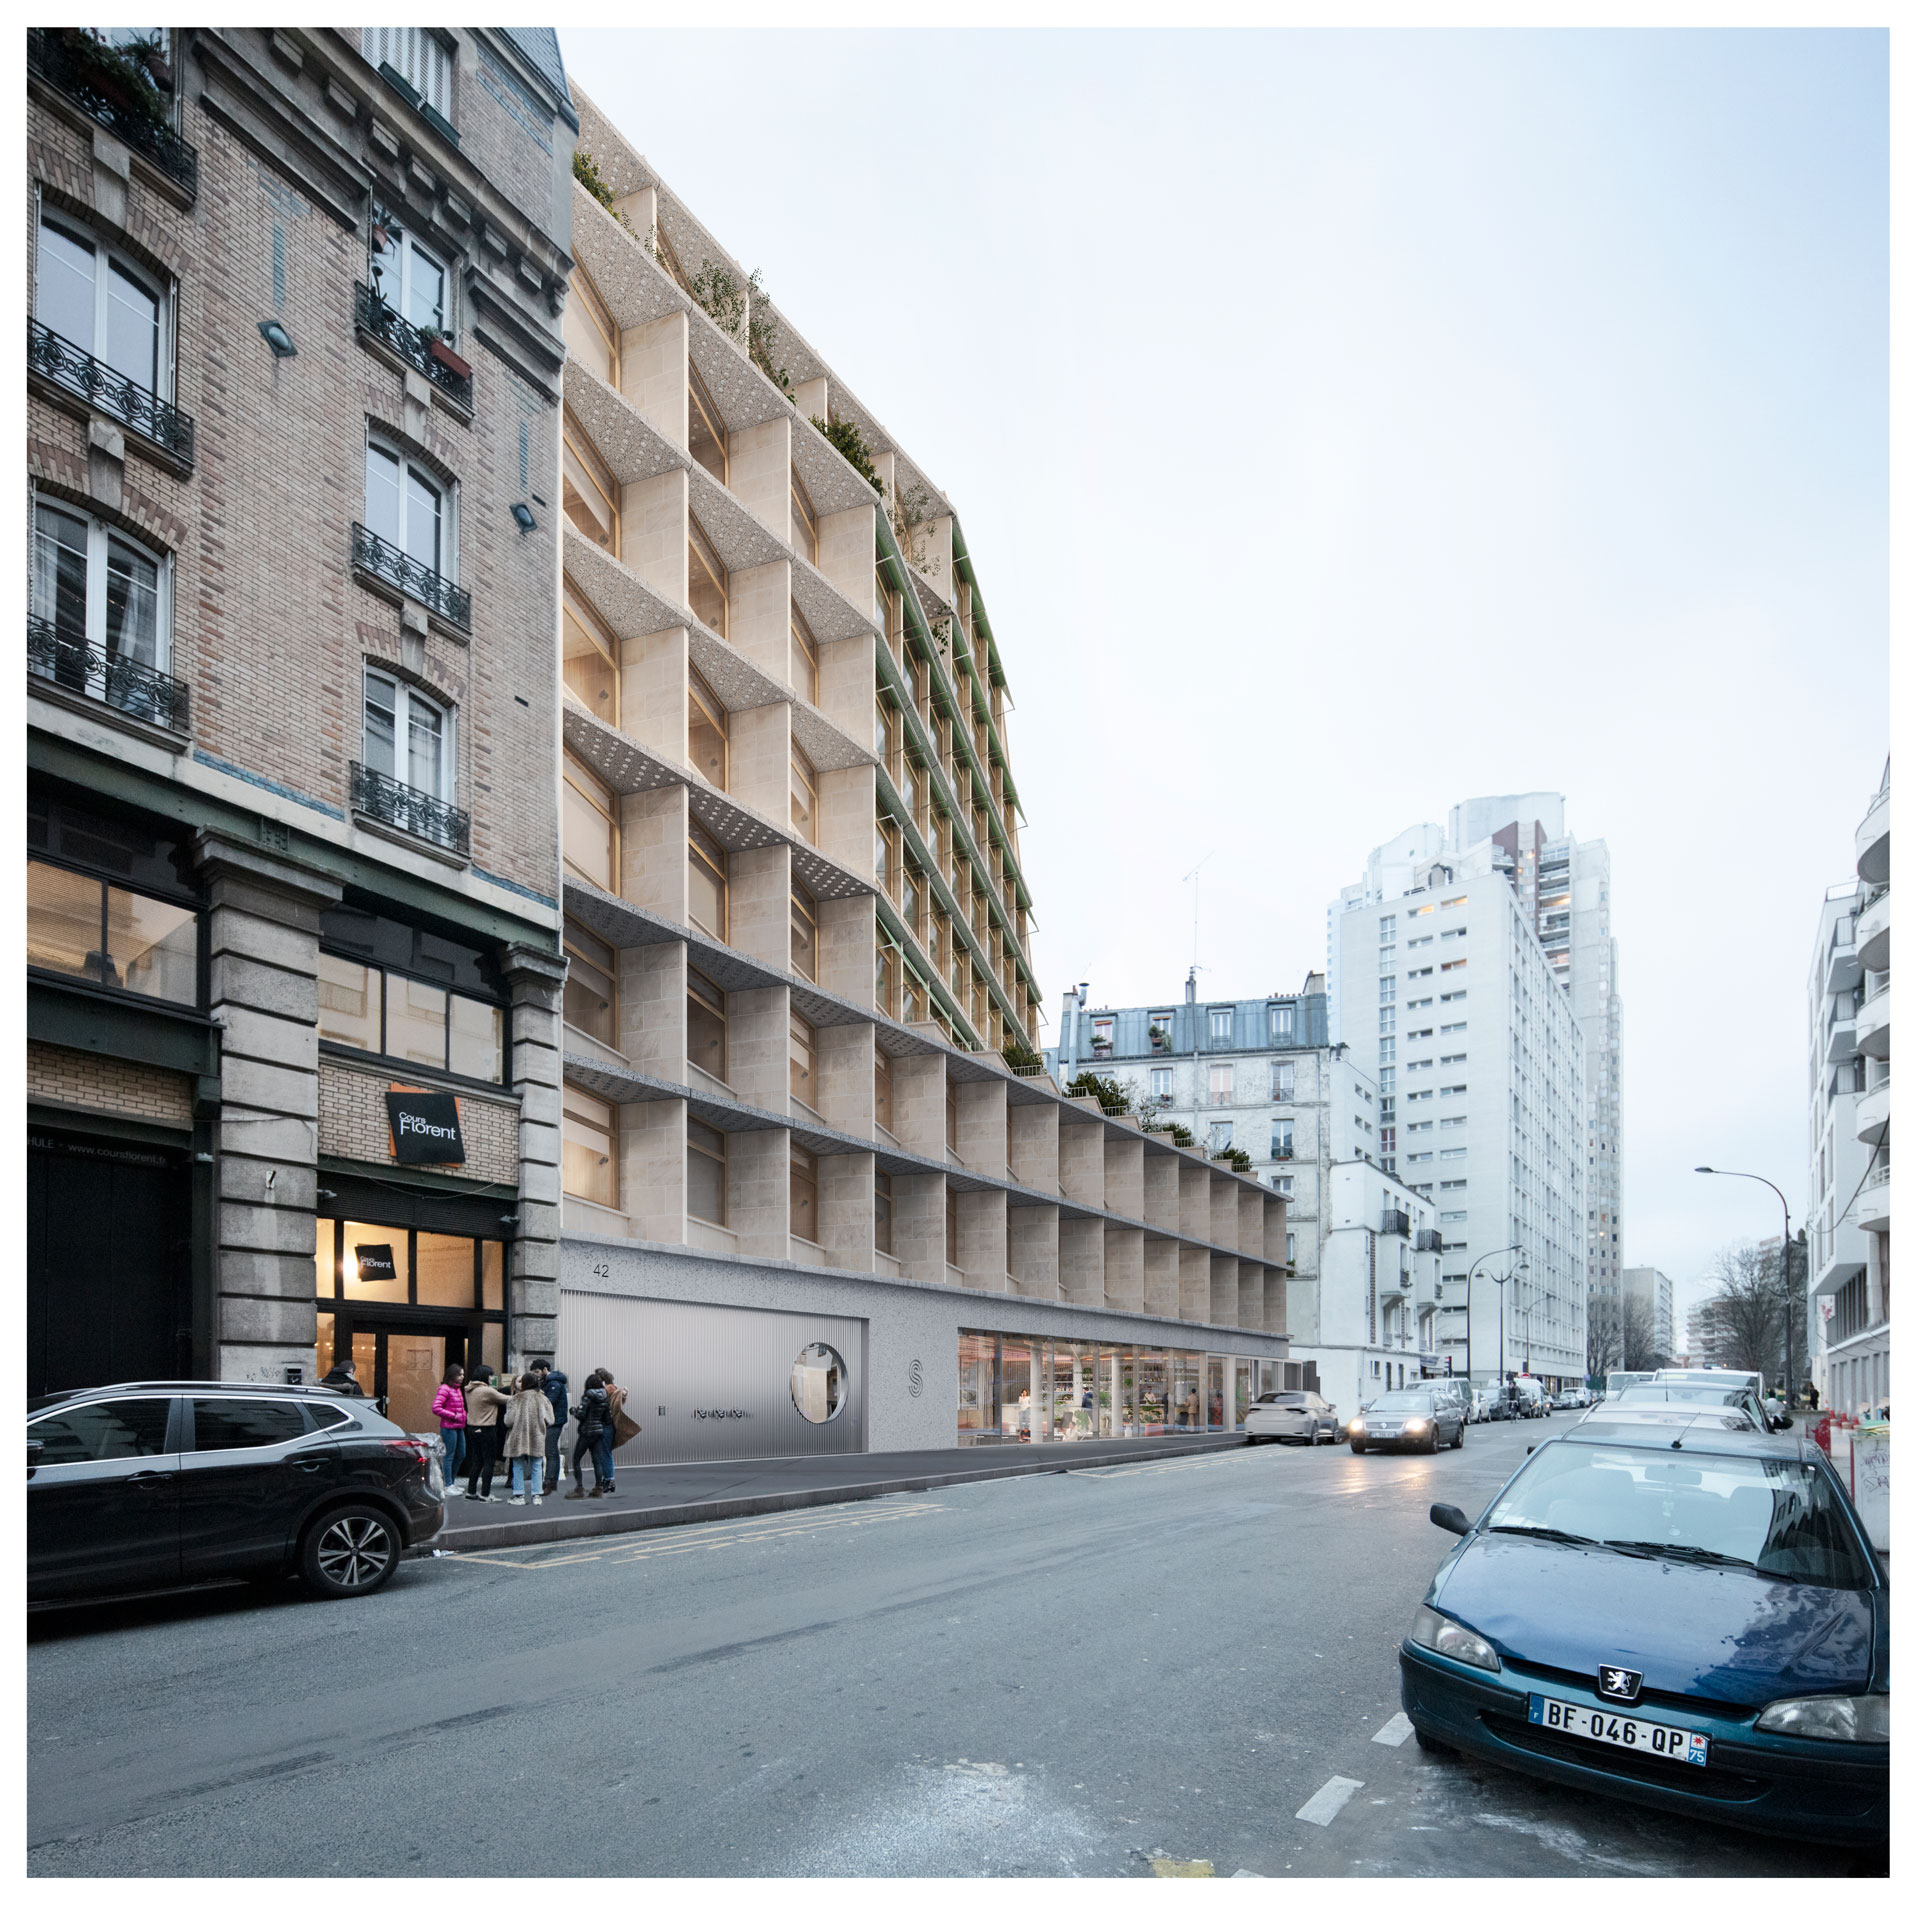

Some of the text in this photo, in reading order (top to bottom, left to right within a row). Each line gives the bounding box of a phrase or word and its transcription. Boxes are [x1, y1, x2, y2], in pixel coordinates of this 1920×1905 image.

[399, 1112, 426, 1124] Cours
[400, 1119, 456, 1140] Florent
[360, 1259, 391, 1269] Florent
[593, 1264, 609, 1278] 42
[1689, 1748, 1705, 1763] 75
